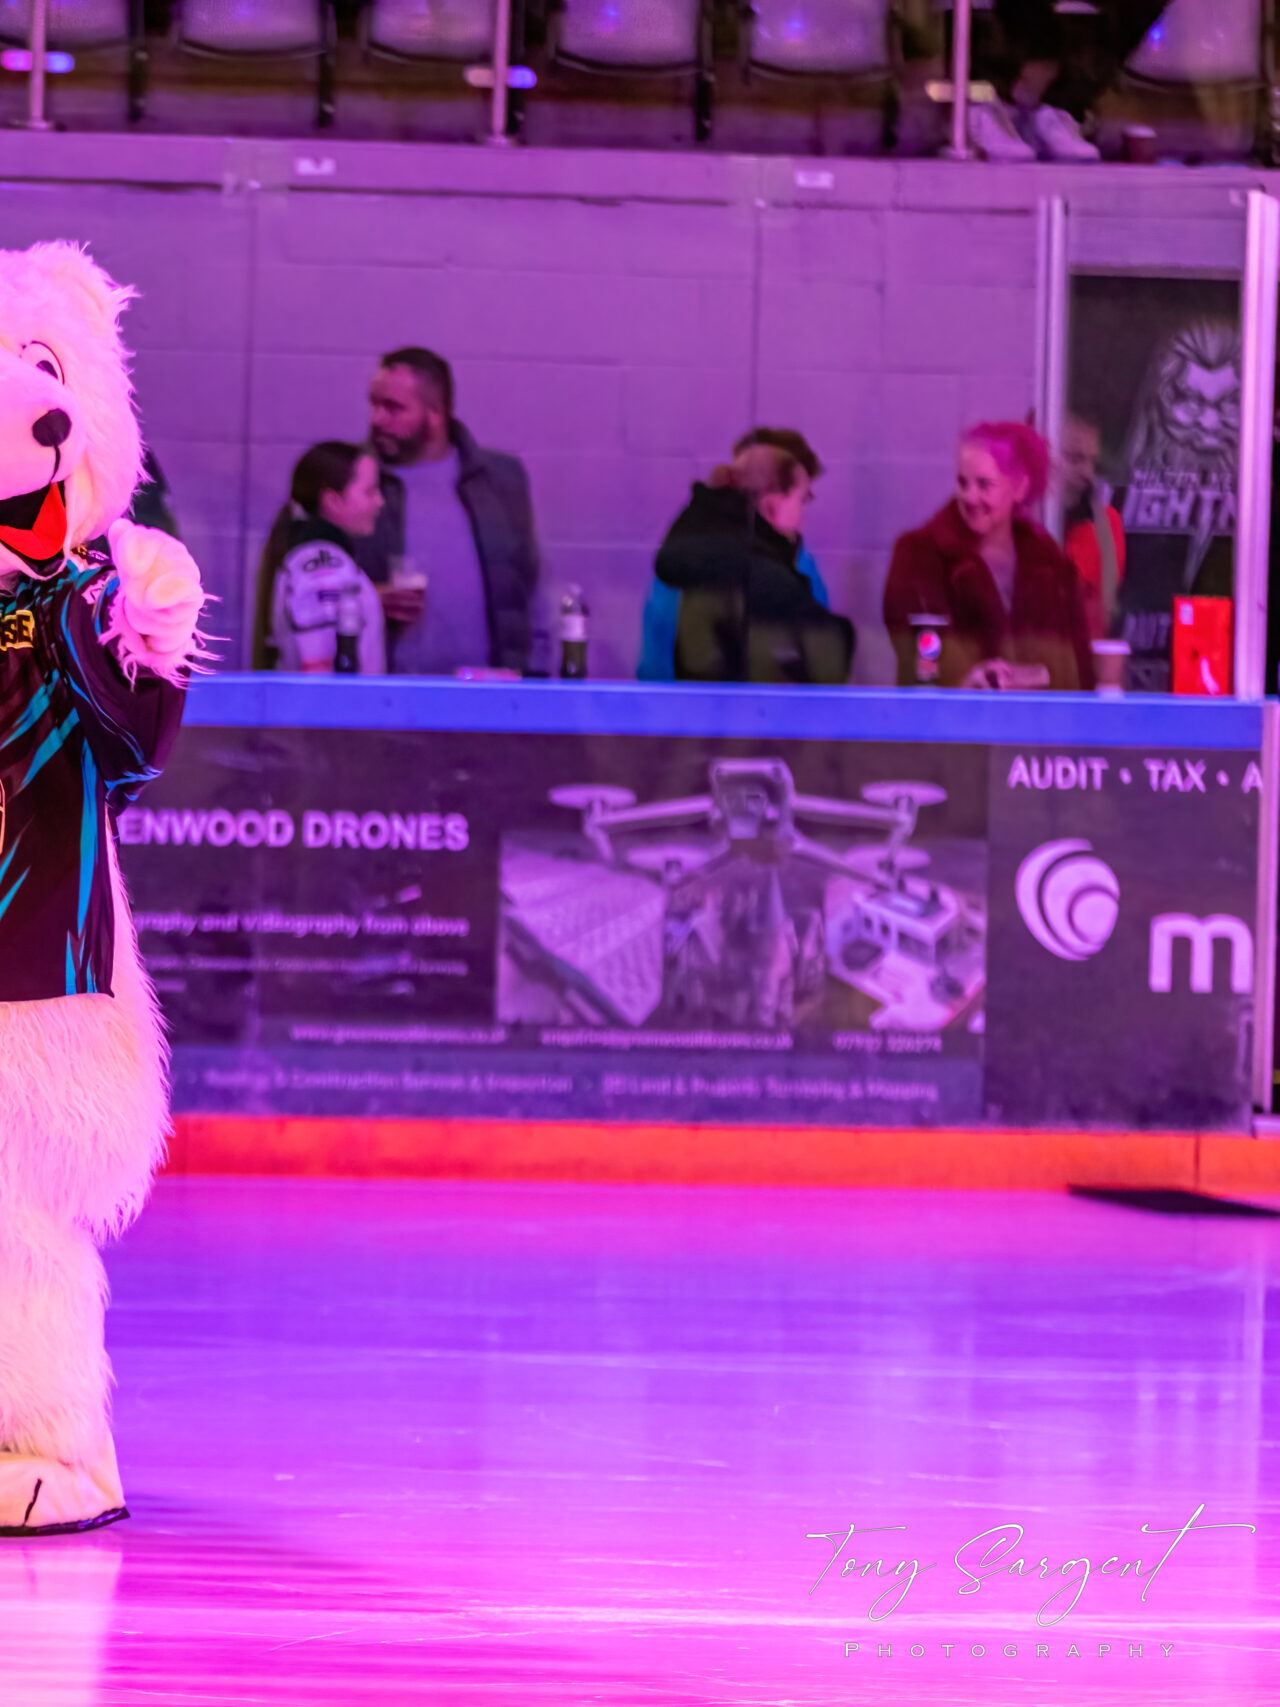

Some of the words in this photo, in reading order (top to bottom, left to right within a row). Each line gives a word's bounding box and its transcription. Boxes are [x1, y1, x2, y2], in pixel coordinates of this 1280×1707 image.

[1007, 755, 1109, 791] AUDIT
[1144, 758, 1207, 793] TAX
[1241, 760, 1263, 793] A
[116, 806, 294, 848] ENWOOD
[302, 810, 470, 851] DRONES
